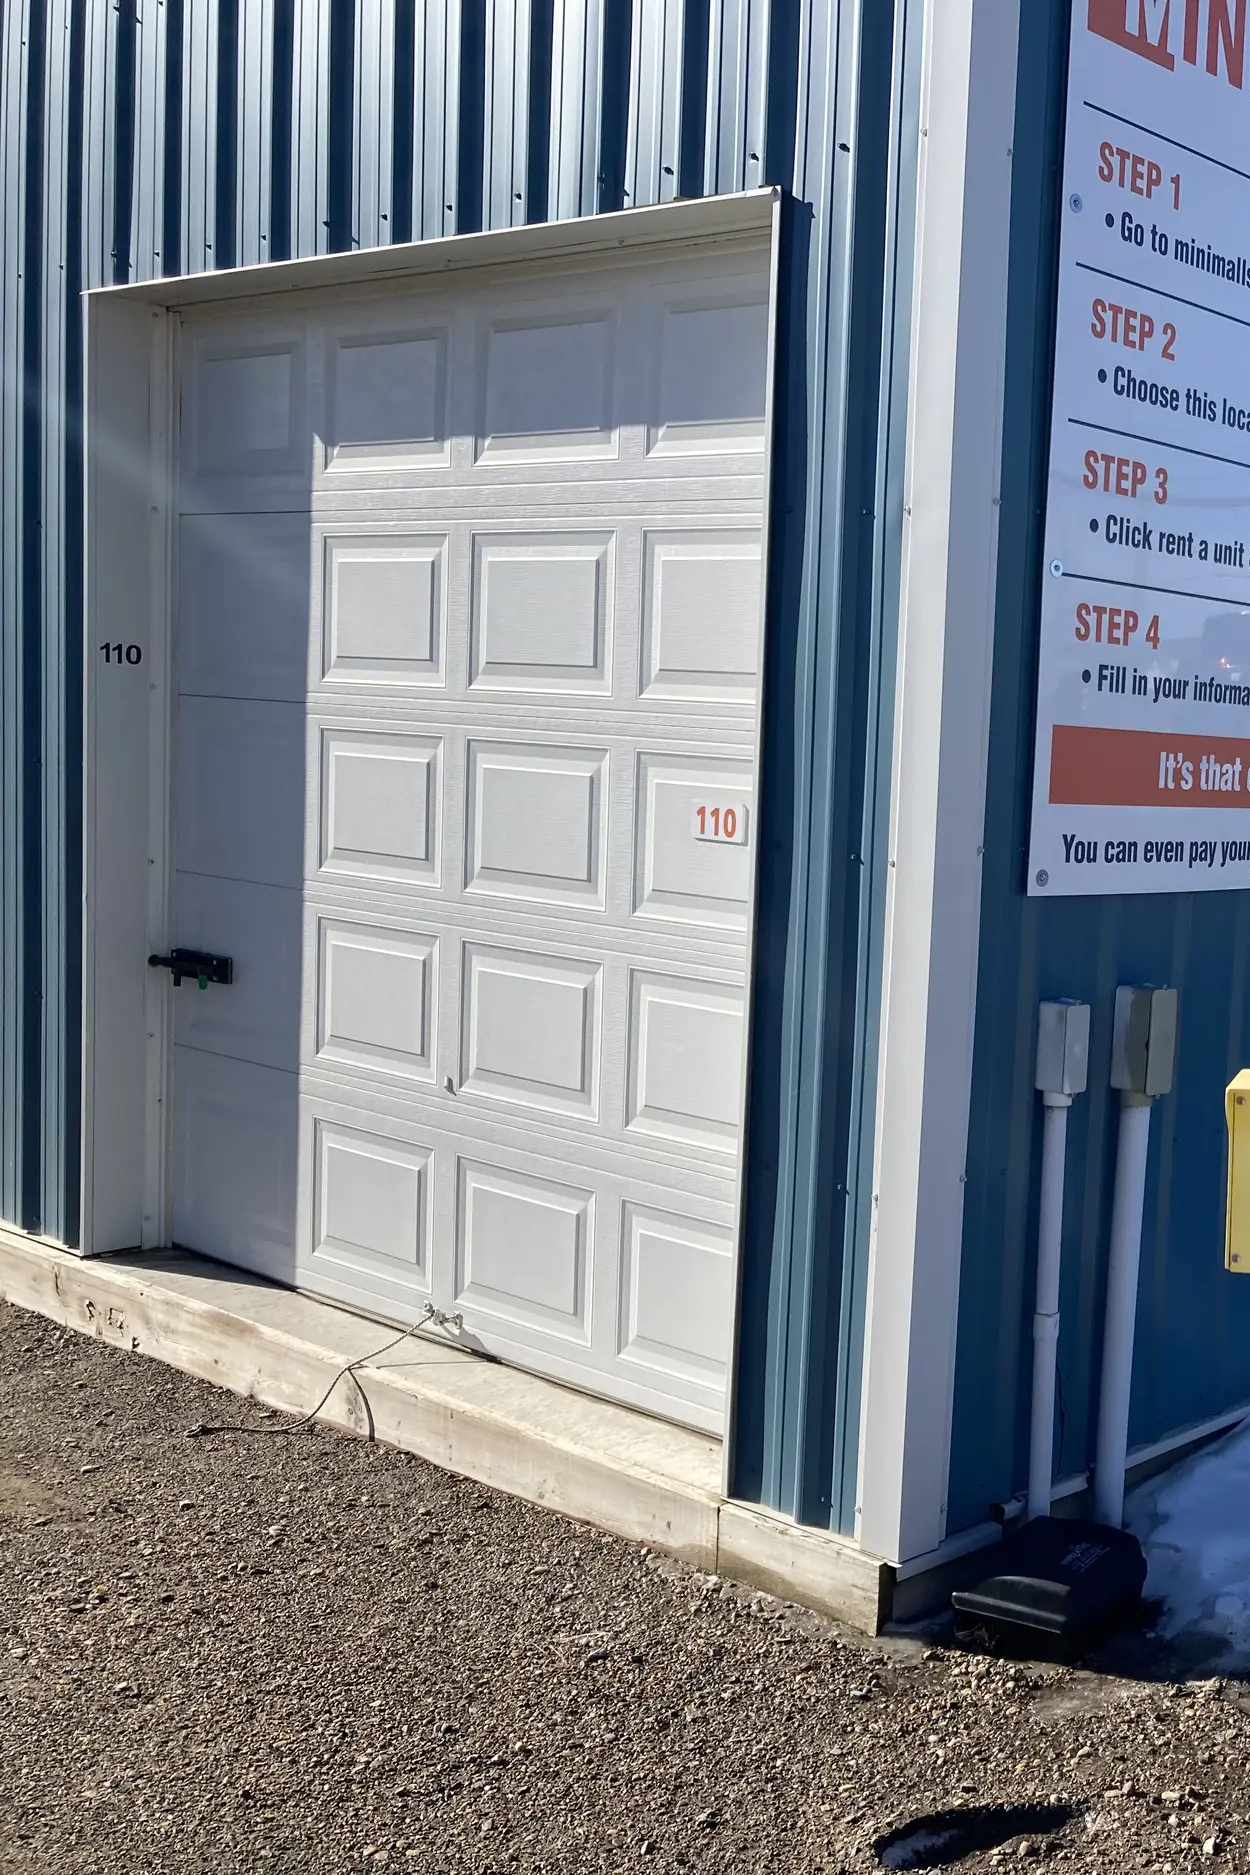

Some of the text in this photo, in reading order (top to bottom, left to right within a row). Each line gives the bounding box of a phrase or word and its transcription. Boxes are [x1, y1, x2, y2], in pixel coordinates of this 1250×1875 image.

[1098, 141, 1181, 210] STEP 1
[1120, 211, 1144, 247] Go
[1151, 224, 1168, 256] to
[1091, 298, 1177, 361] STEP 2
[1113, 366, 1180, 412] Choose
[1185, 388, 1217, 422] this
[1083, 450, 1168, 505] STEP 3
[1105, 514, 1153, 550] Click
[1158, 532, 1193, 558] rent
[1198, 540, 1208, 561] a
[1213, 542, 1244, 568] unit
[1075, 603, 1160, 650] STEP 4
[99, 642, 142, 665] 110
[1097, 664, 1127, 694] Fill
[1132, 667, 1148, 696] in
[1153, 677, 1188, 703] your
[1158, 751, 1193, 790] It's
[1200, 754, 1241, 792] that
[696, 806, 736, 838] 110
[1062, 834, 1097, 864] You
[1104, 840, 1137, 863] can
[1143, 839, 1184, 862] even
[1189, 840, 1218, 868] pay
